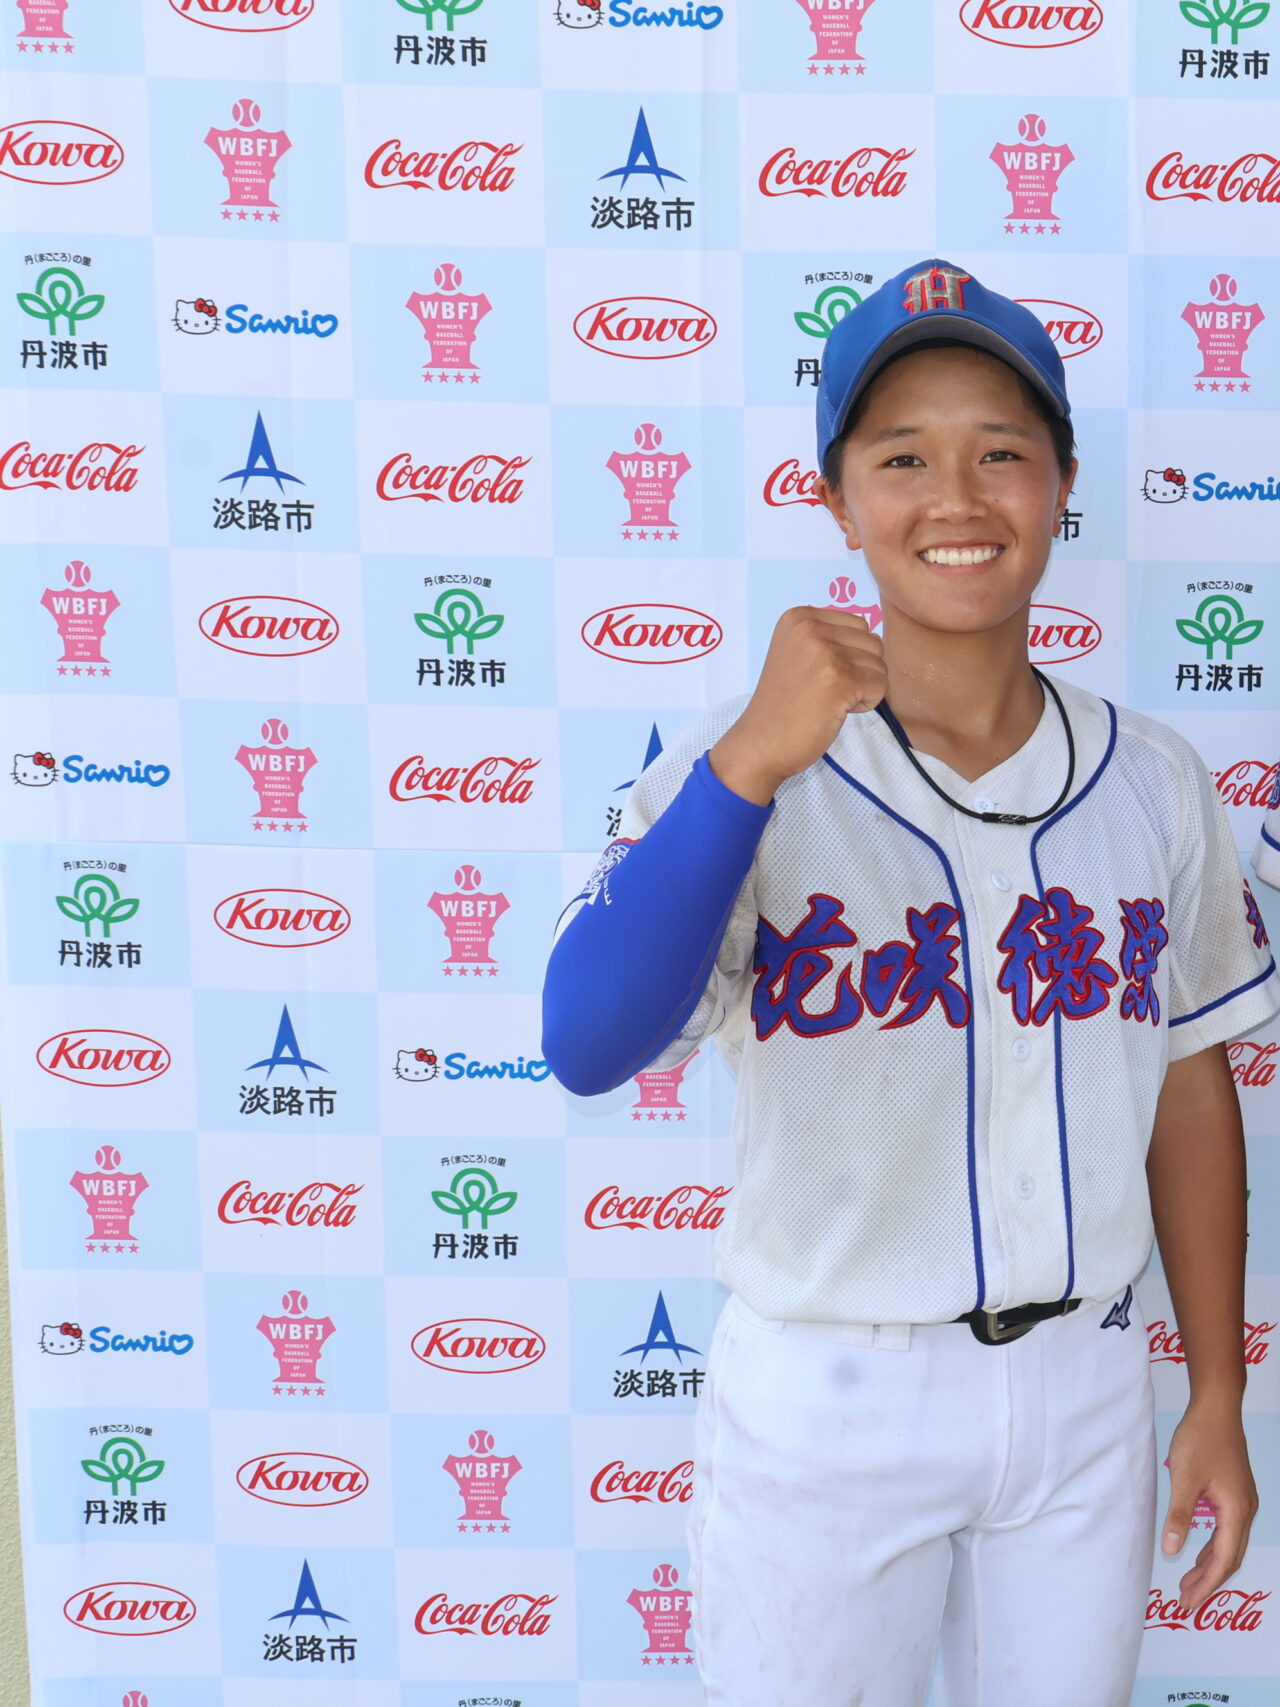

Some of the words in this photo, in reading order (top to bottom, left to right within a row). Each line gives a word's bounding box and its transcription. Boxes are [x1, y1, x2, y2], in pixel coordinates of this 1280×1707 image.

[609, 0, 723, 30] Sanrio
[971, 0, 1098, 31] Kowa
[395, 36, 487, 66] 丹波市
[1180, 49, 1269, 79] 丹波市
[0, 131, 119, 168] Kowa
[218, 136, 278, 157] WBFJ
[1004, 152, 1062, 170] WBFJ
[365, 139, 522, 192] Coca-Cola
[759, 147, 914, 197] Coca-Cola
[592, 197, 694, 230] 淡路市
[903, 267, 972, 315] H
[225, 304, 338, 338] Sanrio
[420, 301, 478, 320] WBFJ
[585, 307, 712, 342] Kowa
[1195, 312, 1252, 330] WBFJ
[21, 341, 107, 369] 丹波市
[0, 441, 144, 492] Coca-Cola
[376, 453, 530, 503] Coca-Cola
[620, 460, 678, 478] WBFJ
[213, 498, 314, 532] 淡路市
[52, 597, 107, 616] WBFJ
[211, 605, 334, 640] Kowa
[594, 614, 718, 647] Kowa
[417, 659, 505, 686] 丹波市
[1176, 664, 1263, 691] 丹波市
[62, 755, 170, 787] Sanrio
[248, 754, 305, 772] WBFJ
[390, 755, 539, 803] Coca-Cola
[226, 898, 345, 931] Kowa
[440, 900, 497, 918] WBFJ
[59, 940, 141, 968] 丹波市
[49, 1037, 166, 1071] Kowa
[444, 1062, 552, 1093] Sanrio
[240, 1086, 336, 1116] 淡路市
[82, 1180, 136, 1196] WBFJ
[218, 1180, 362, 1227] Coca-Cola
[585, 1186, 731, 1230] Coca-Cola
[433, 1234, 518, 1259] 丹波市
[89, 1326, 194, 1355] Sanrio
[269, 1324, 323, 1340] WBFJ
[422, 1328, 541, 1358] Kowa
[248, 1461, 363, 1492] Kowa
[455, 1463, 510, 1478] WBFJ
[85, 1500, 166, 1524] 丹波市
[76, 1592, 191, 1621] Kowa
[415, 1593, 556, 1635] Coca-Cola
[264, 1634, 357, 1663] 淡路市
